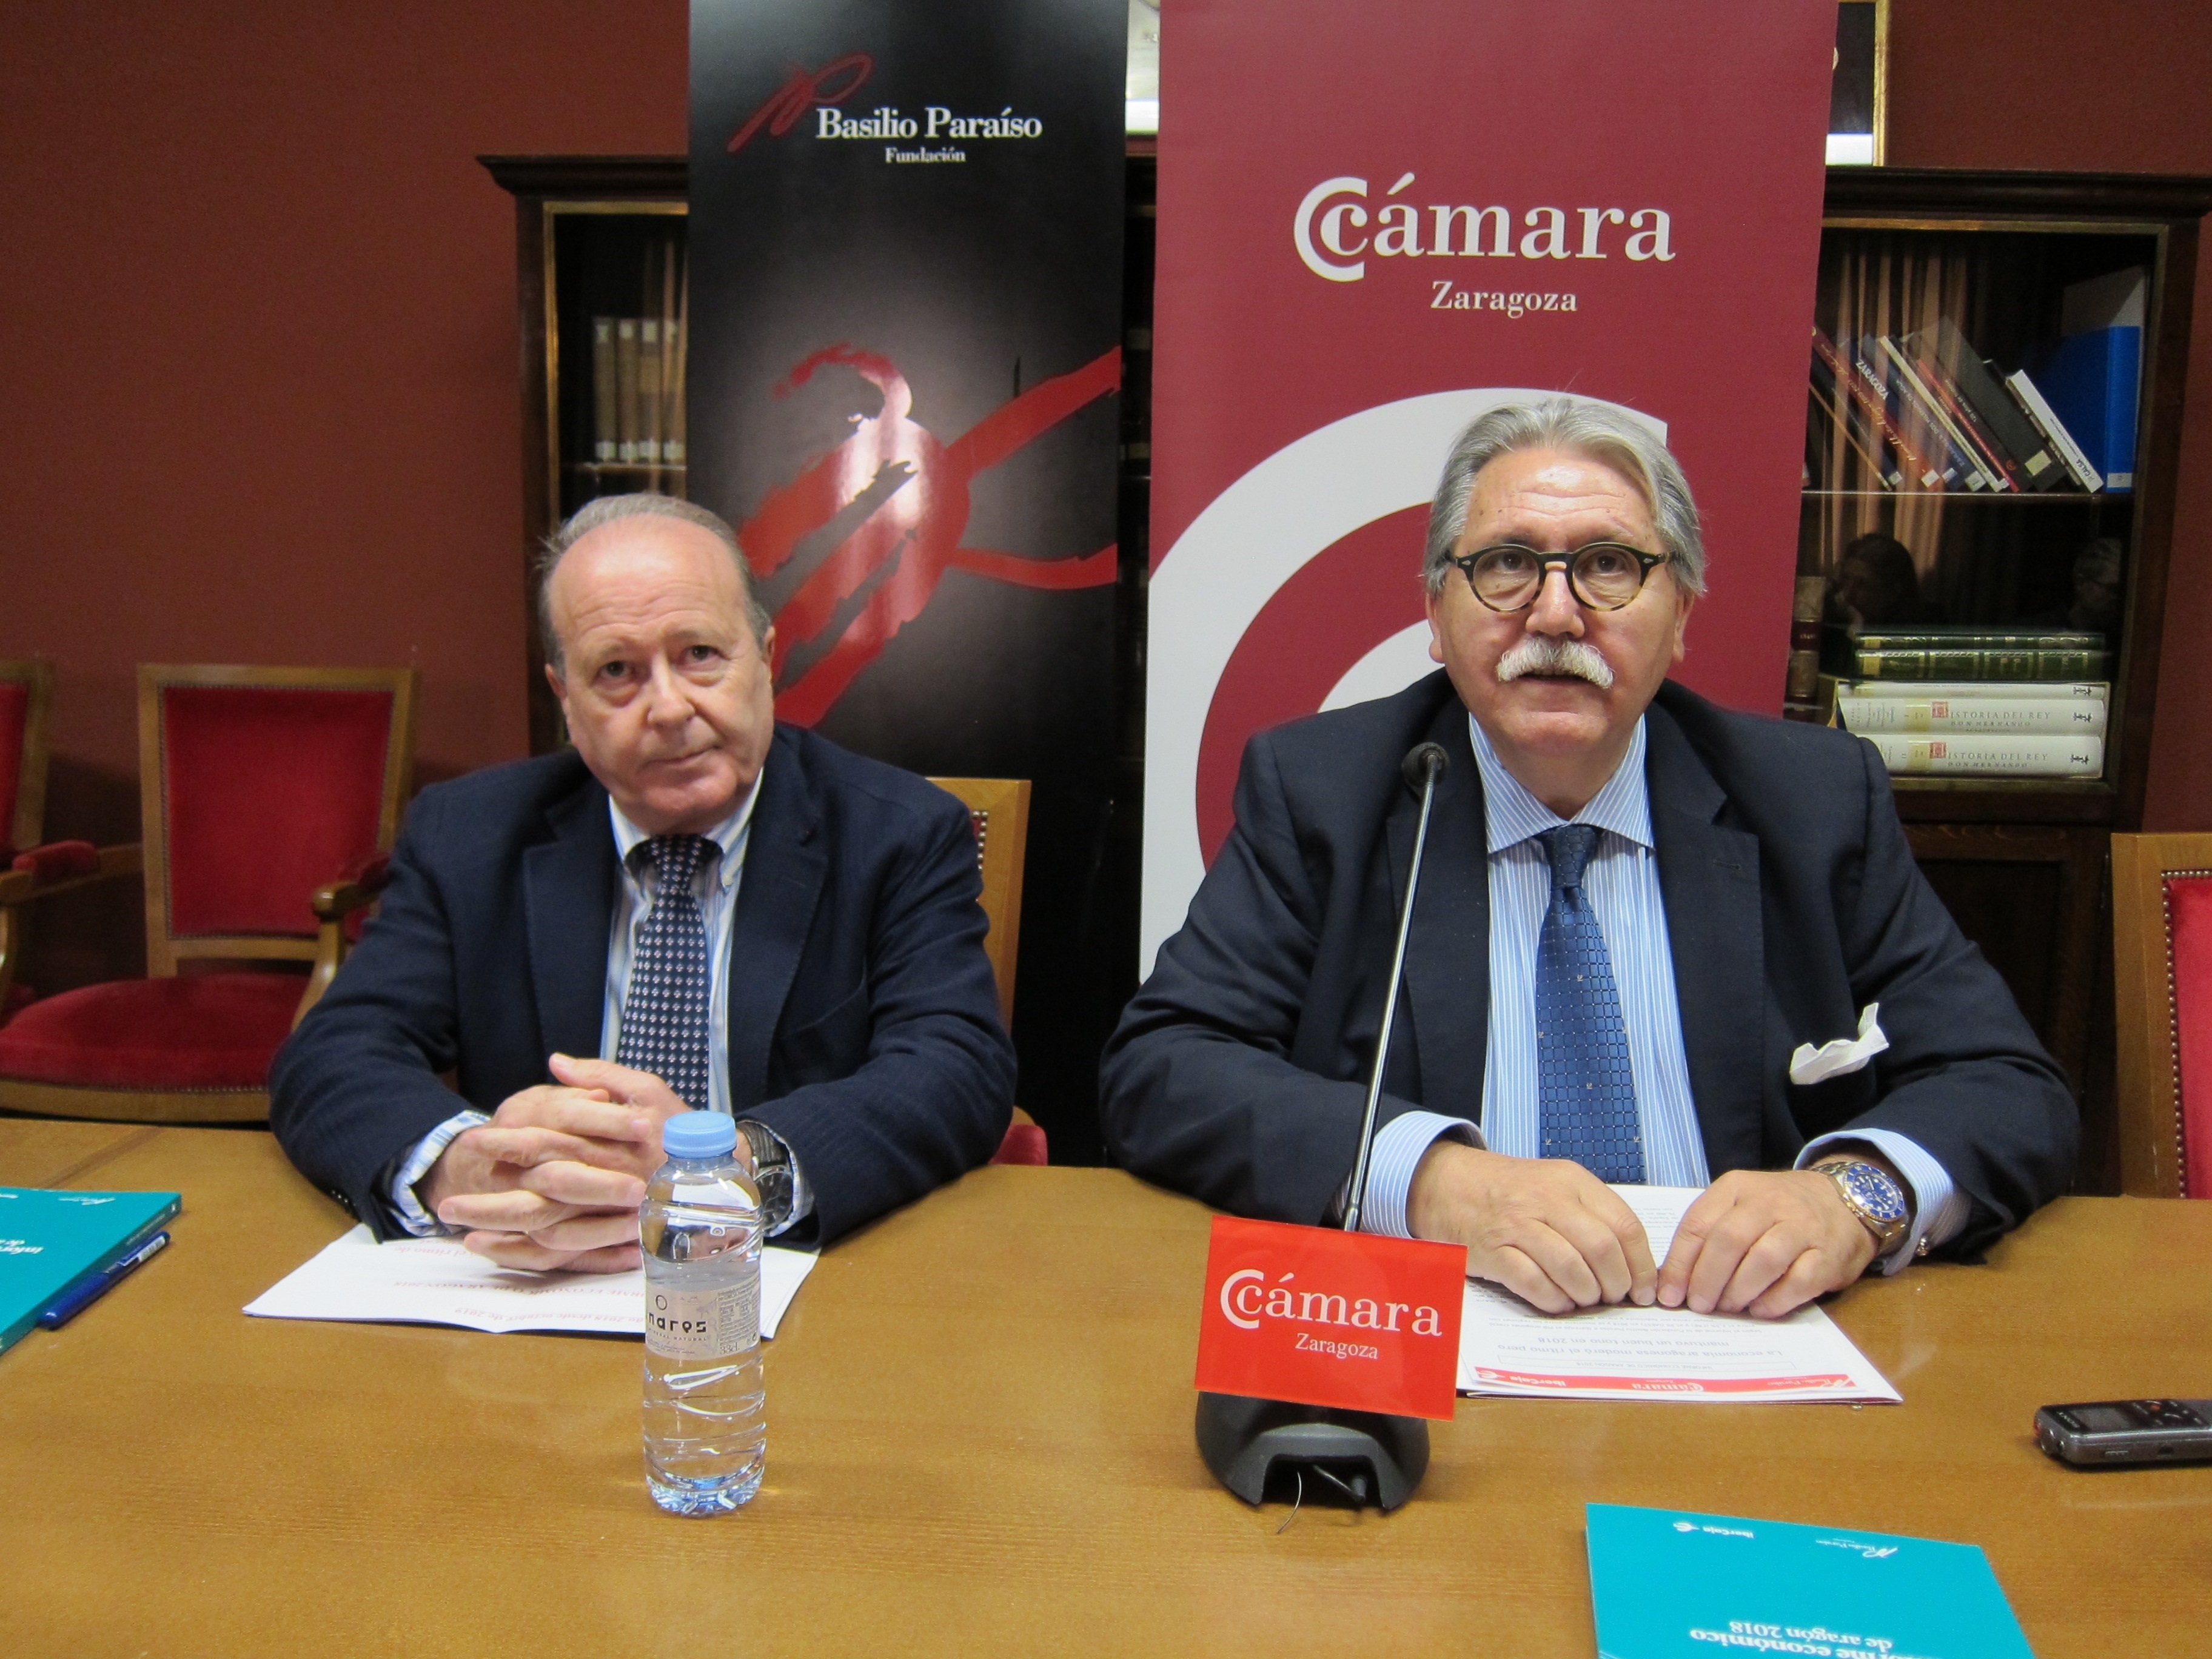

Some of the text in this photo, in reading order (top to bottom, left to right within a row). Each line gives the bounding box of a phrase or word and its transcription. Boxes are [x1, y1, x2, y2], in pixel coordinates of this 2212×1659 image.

[816, 106, 1042, 139] Basilio Paraíso
[886, 147, 966, 163] Fundación
[1430, 281, 1578, 318] Zaragoza
[1855, 358, 1889, 400] ZARAGOZA
[1295, 1332, 1379, 1359] Zaragoza
[1689, 1629, 1832, 1657] económico
[1729, 1621, 1783, 1638] 2018
[1785, 1627, 1862, 1645] aragón
[1864, 1638, 1893, 1653] de
